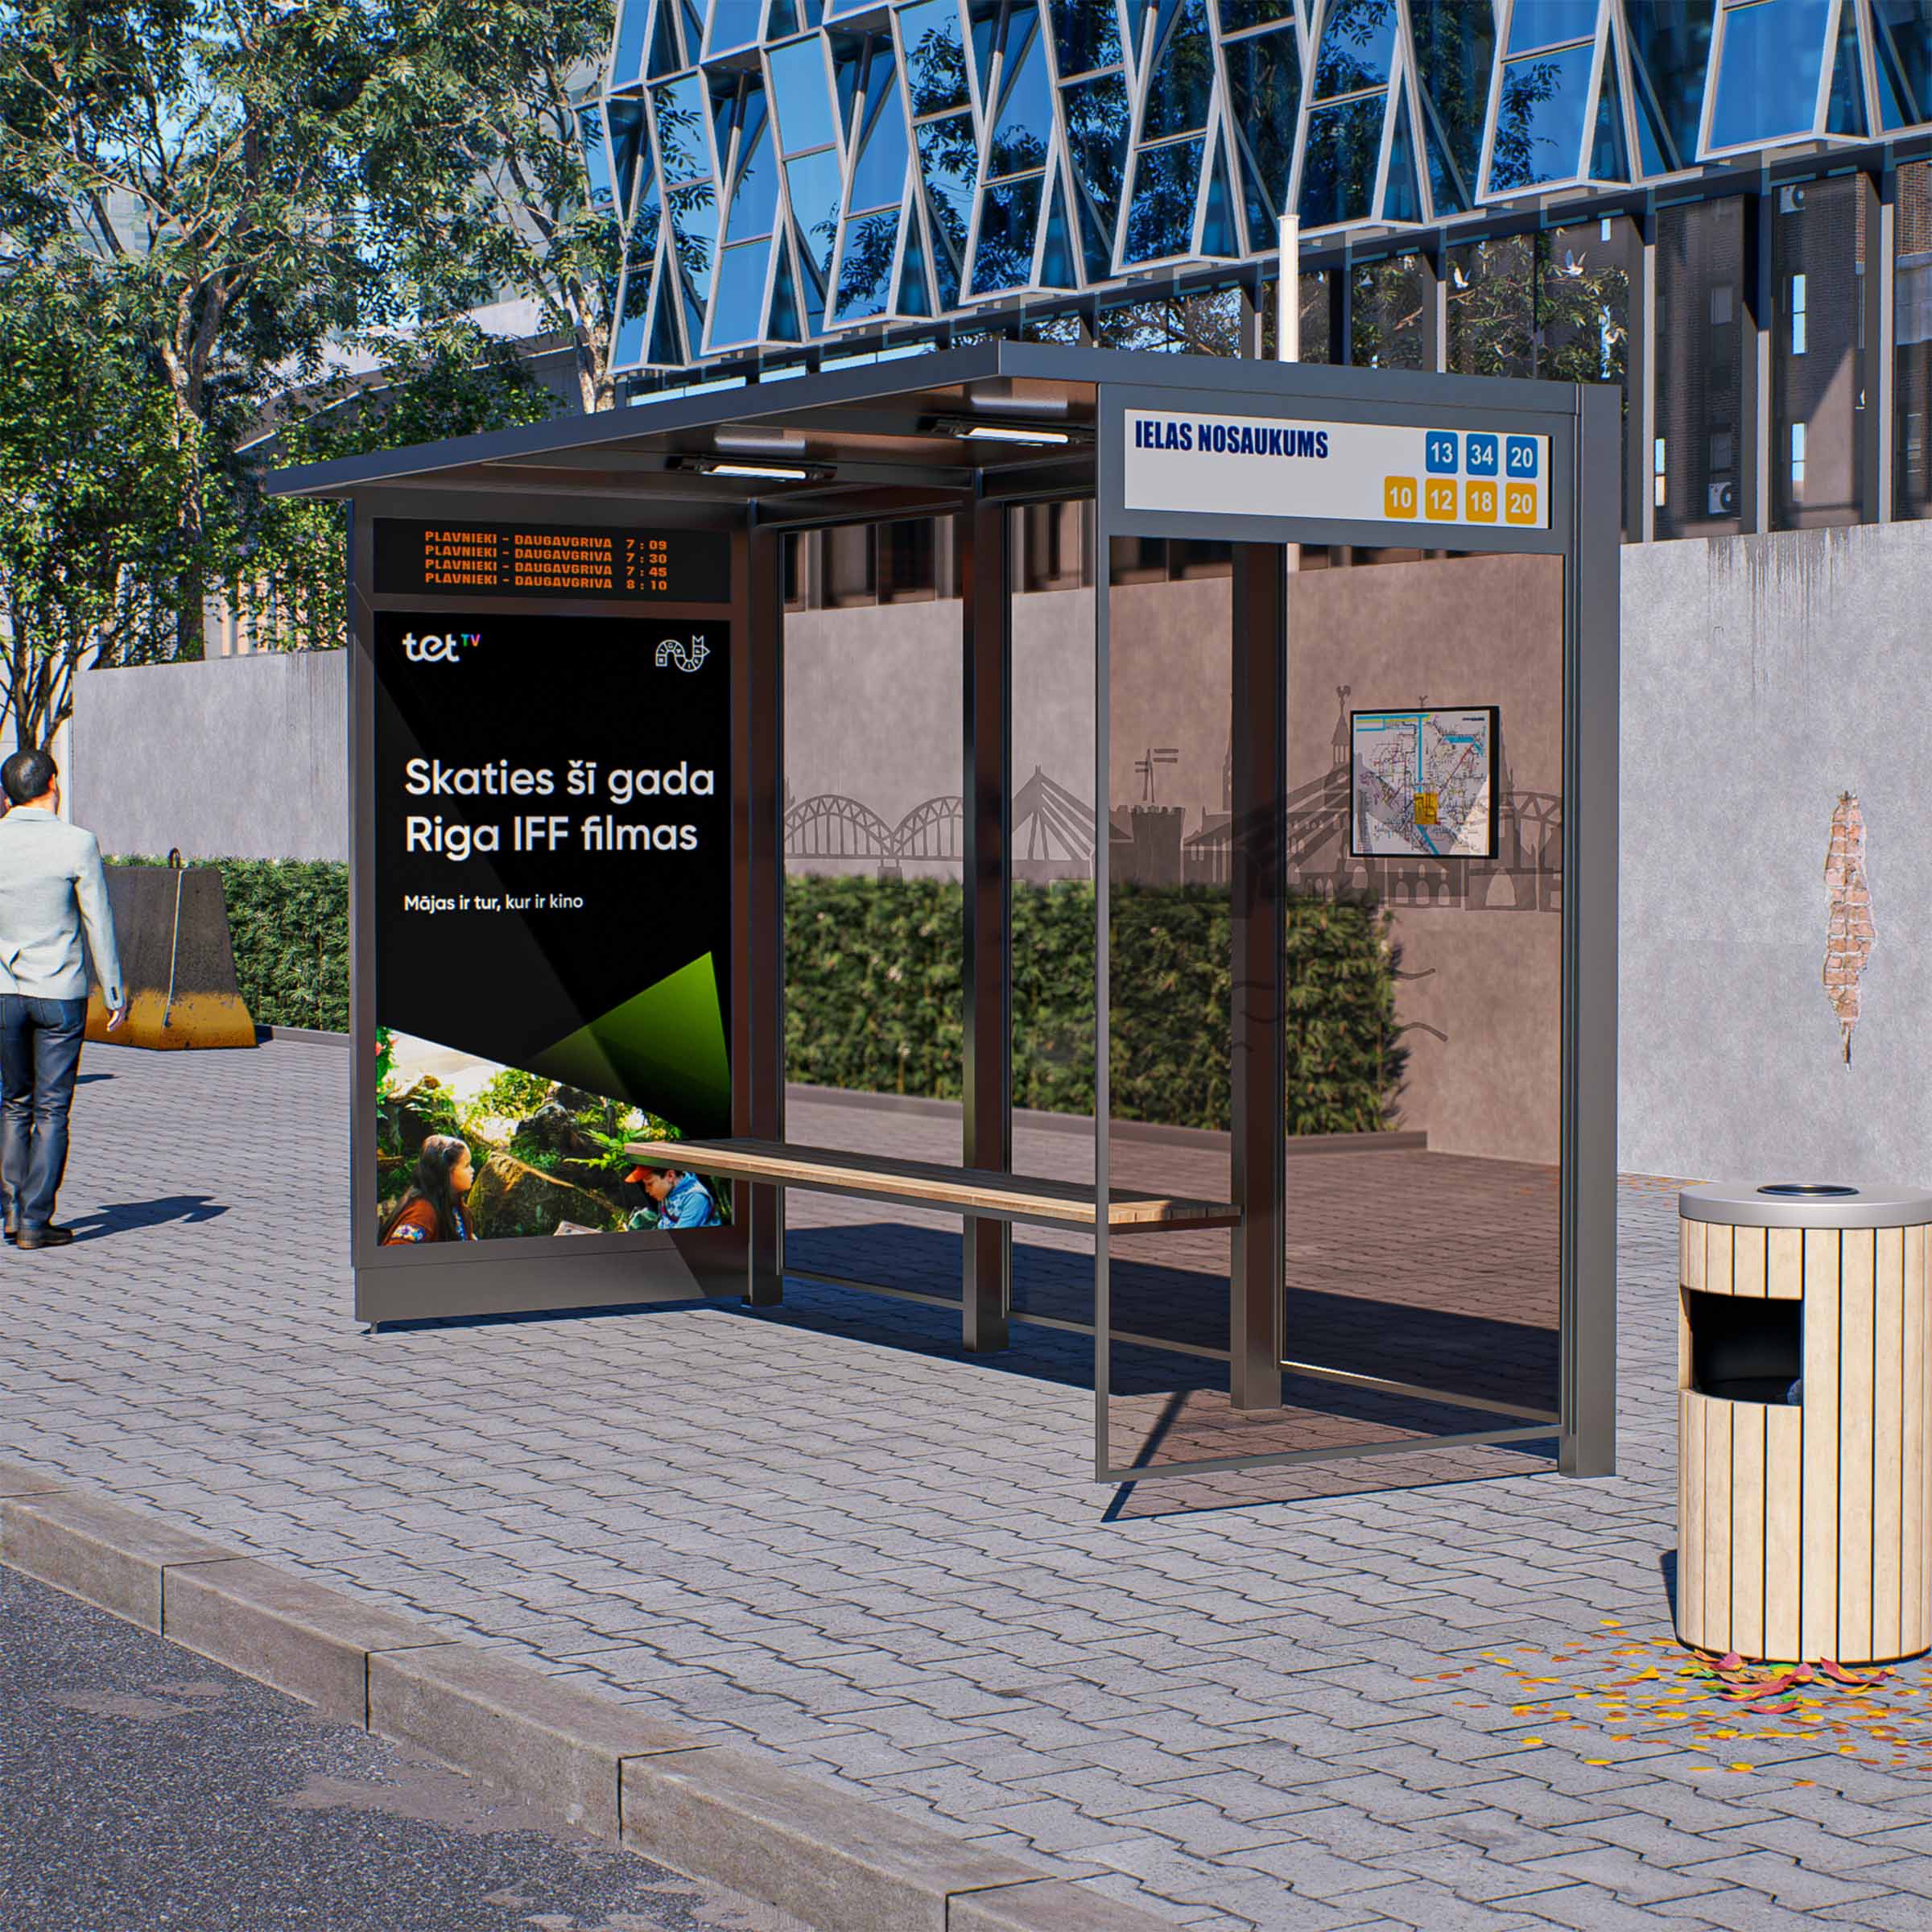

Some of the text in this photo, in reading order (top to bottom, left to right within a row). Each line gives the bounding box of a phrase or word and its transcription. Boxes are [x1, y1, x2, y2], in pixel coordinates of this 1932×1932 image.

[1135, 419, 1329, 459] IELAS NOSAUKUMS
[1430, 441, 1534, 468] 13 34 20
[1389, 486, 1533, 514] 10 12 18 20
[425, 530, 497, 543] PLAVNIEKI
[514, 535, 613, 547] DAUGAVGRIVA
[425, 545, 497, 557] PLAVNIEKI
[514, 548, 613, 561] DAUGAVGRIVA
[425, 559, 497, 571] PLAVNIEKI
[514, 562, 613, 575] DAUGAVGRIVA
[425, 572, 497, 584] PLAVNIEKI
[514, 576, 613, 588] DAUGAVGRIVA
[402, 632, 481, 663] tet TV
[405, 758, 715, 804] Skaties šī gada
[406, 815, 698, 861] Riga IFF filmas
[404, 893, 584, 914] Mājas ir tur, kur ir kino
